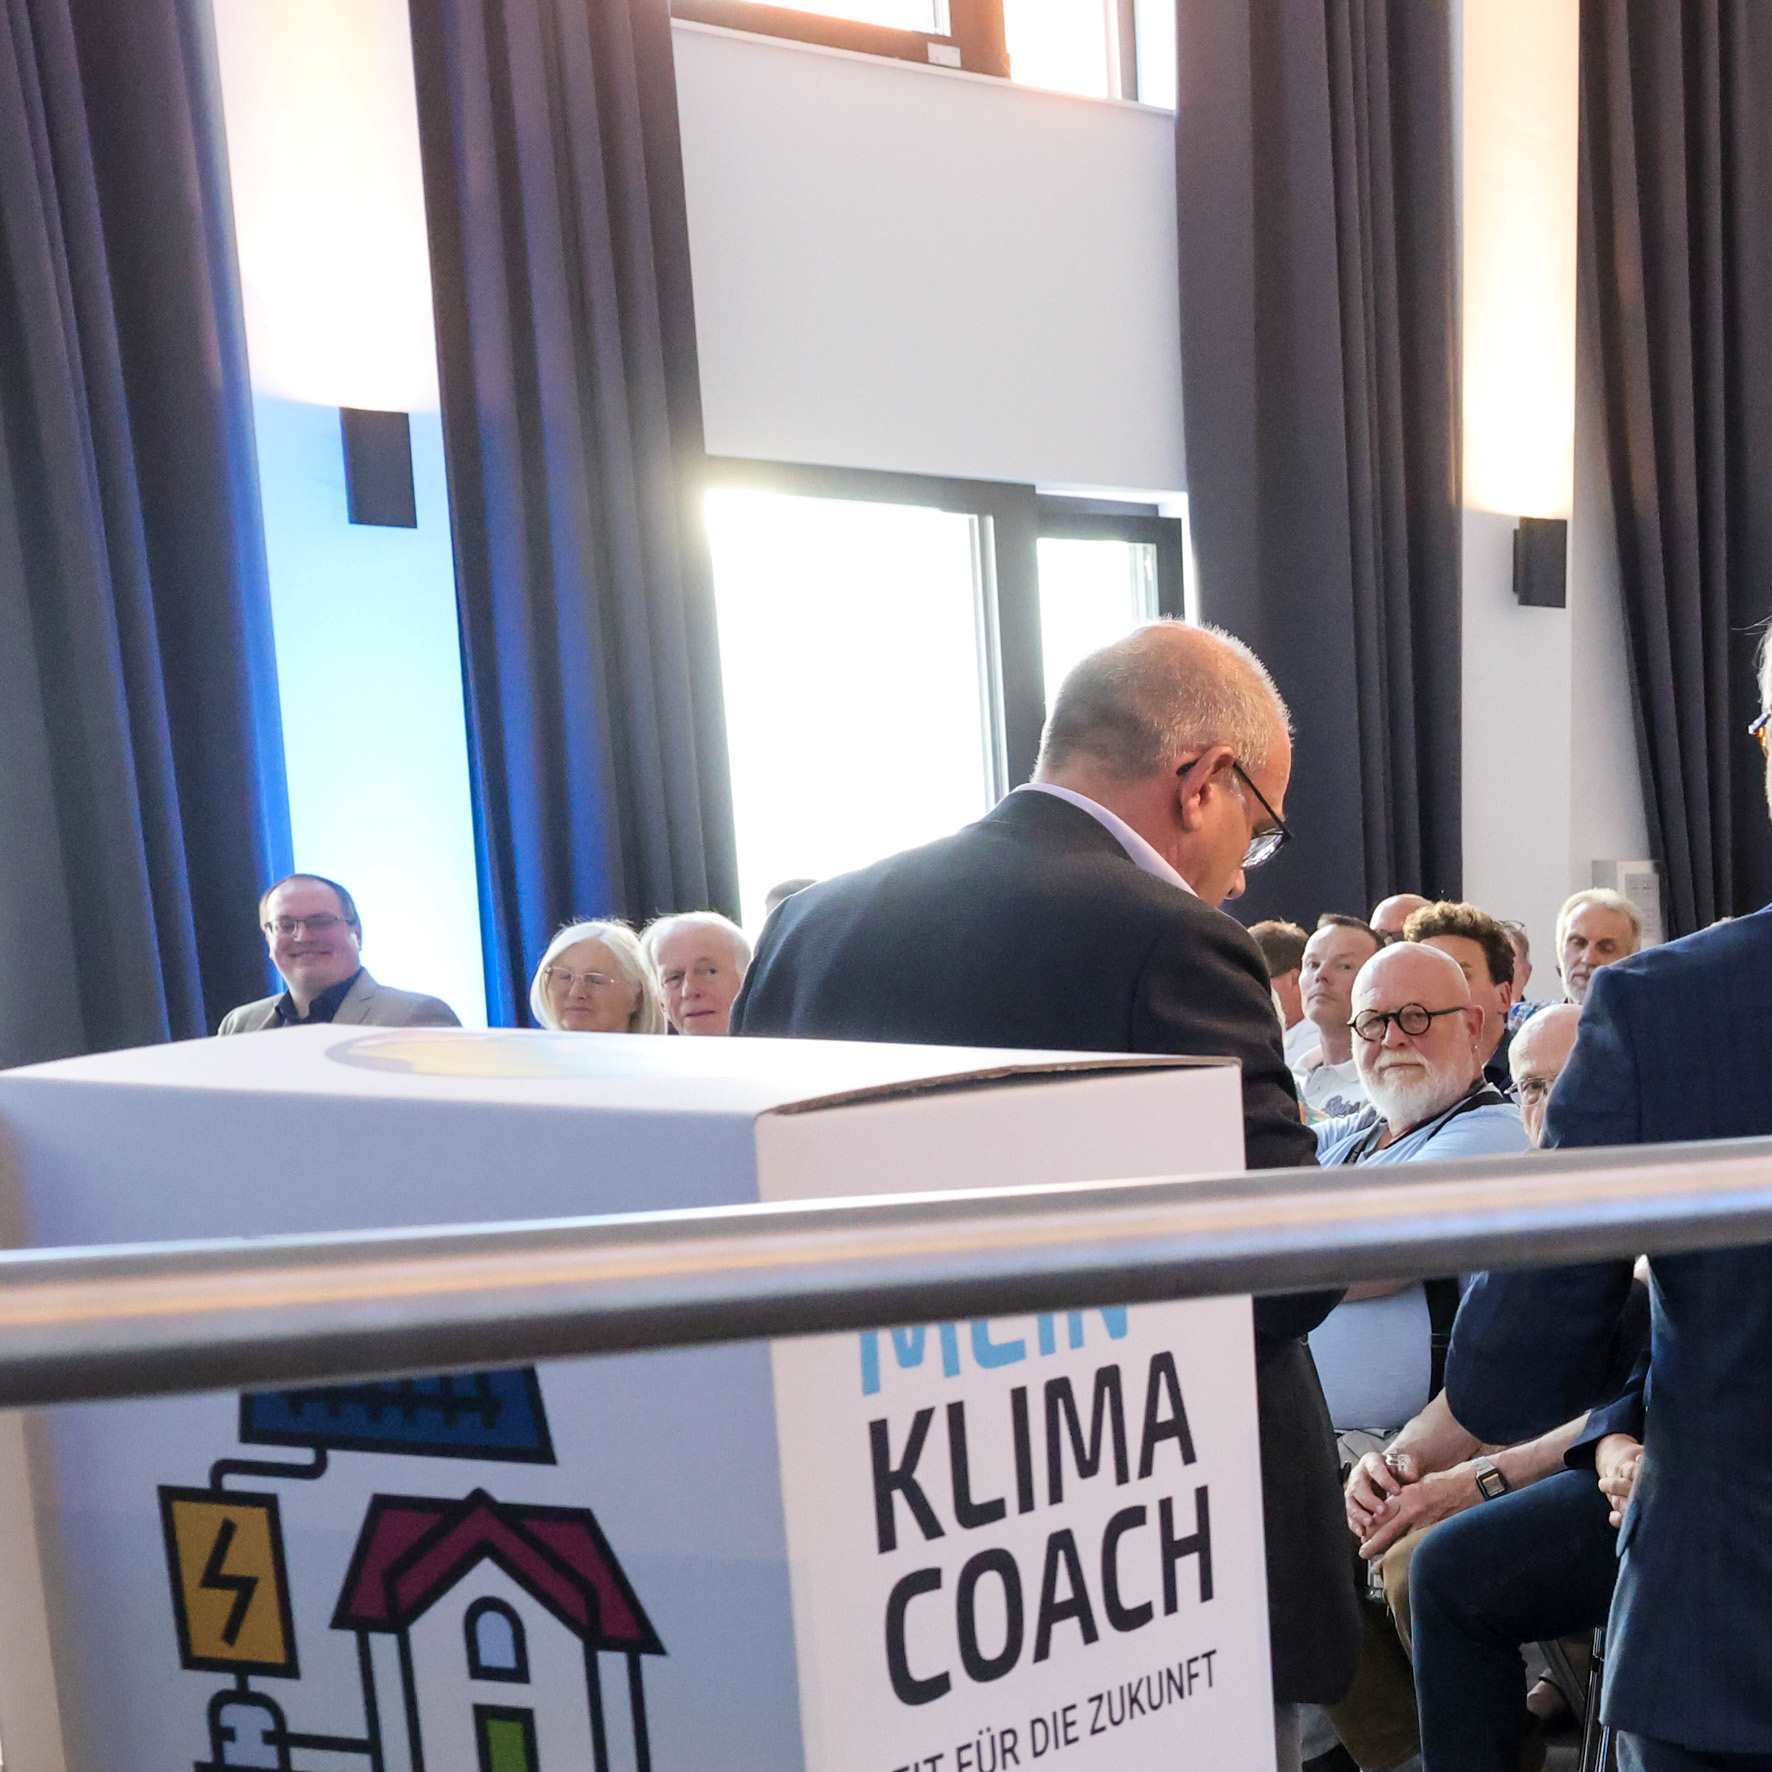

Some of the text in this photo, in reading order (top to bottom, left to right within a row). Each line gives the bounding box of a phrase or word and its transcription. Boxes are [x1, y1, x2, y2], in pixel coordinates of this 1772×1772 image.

[868, 1350, 1198, 1554] KLIMA
[885, 1485, 1214, 1707] COACH
[1030, 1704, 1080, 1759] DIE
[1088, 1650, 1218, 1736] ZUKUNFT
